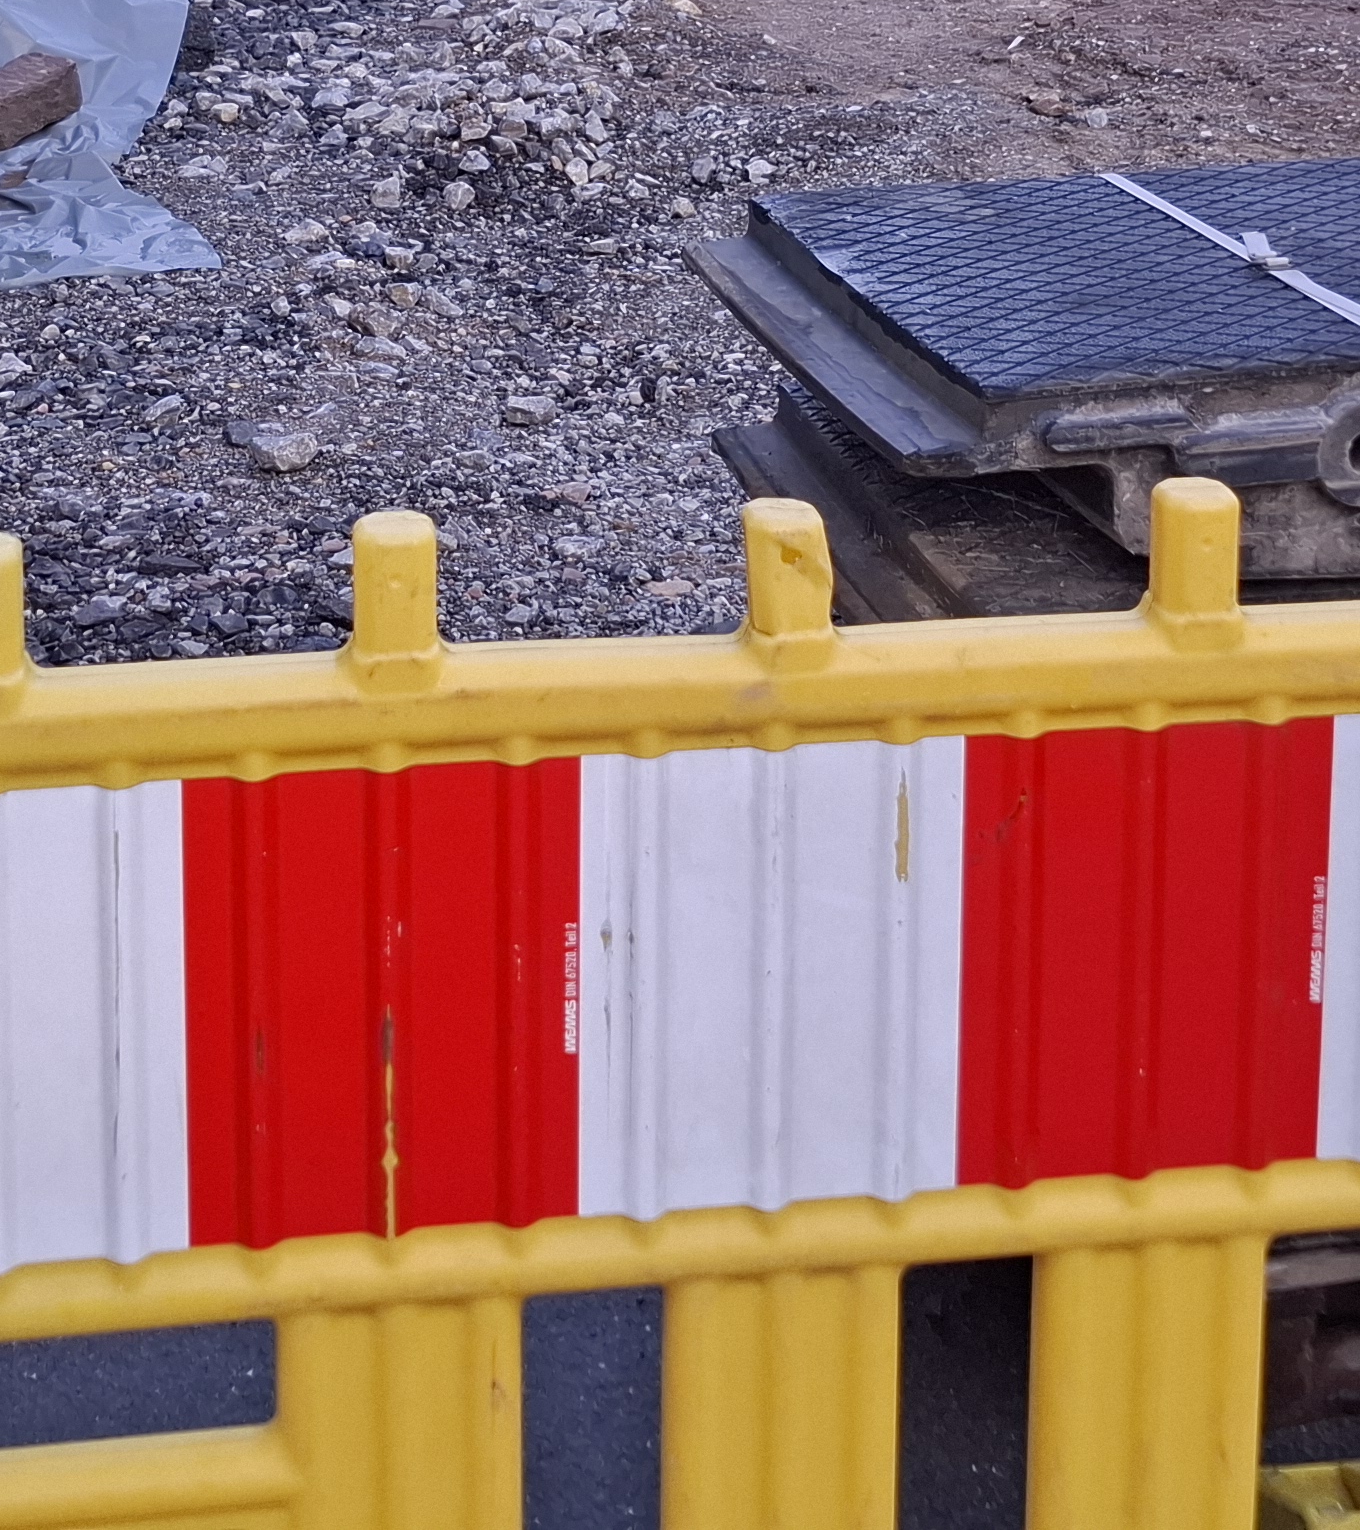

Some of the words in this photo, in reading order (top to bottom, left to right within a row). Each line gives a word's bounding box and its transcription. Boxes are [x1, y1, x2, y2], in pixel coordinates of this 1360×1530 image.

[565, 931, 576, 947] Teil
[565, 981, 576, 997] DIN
[565, 999, 576, 1053] WEMAS
